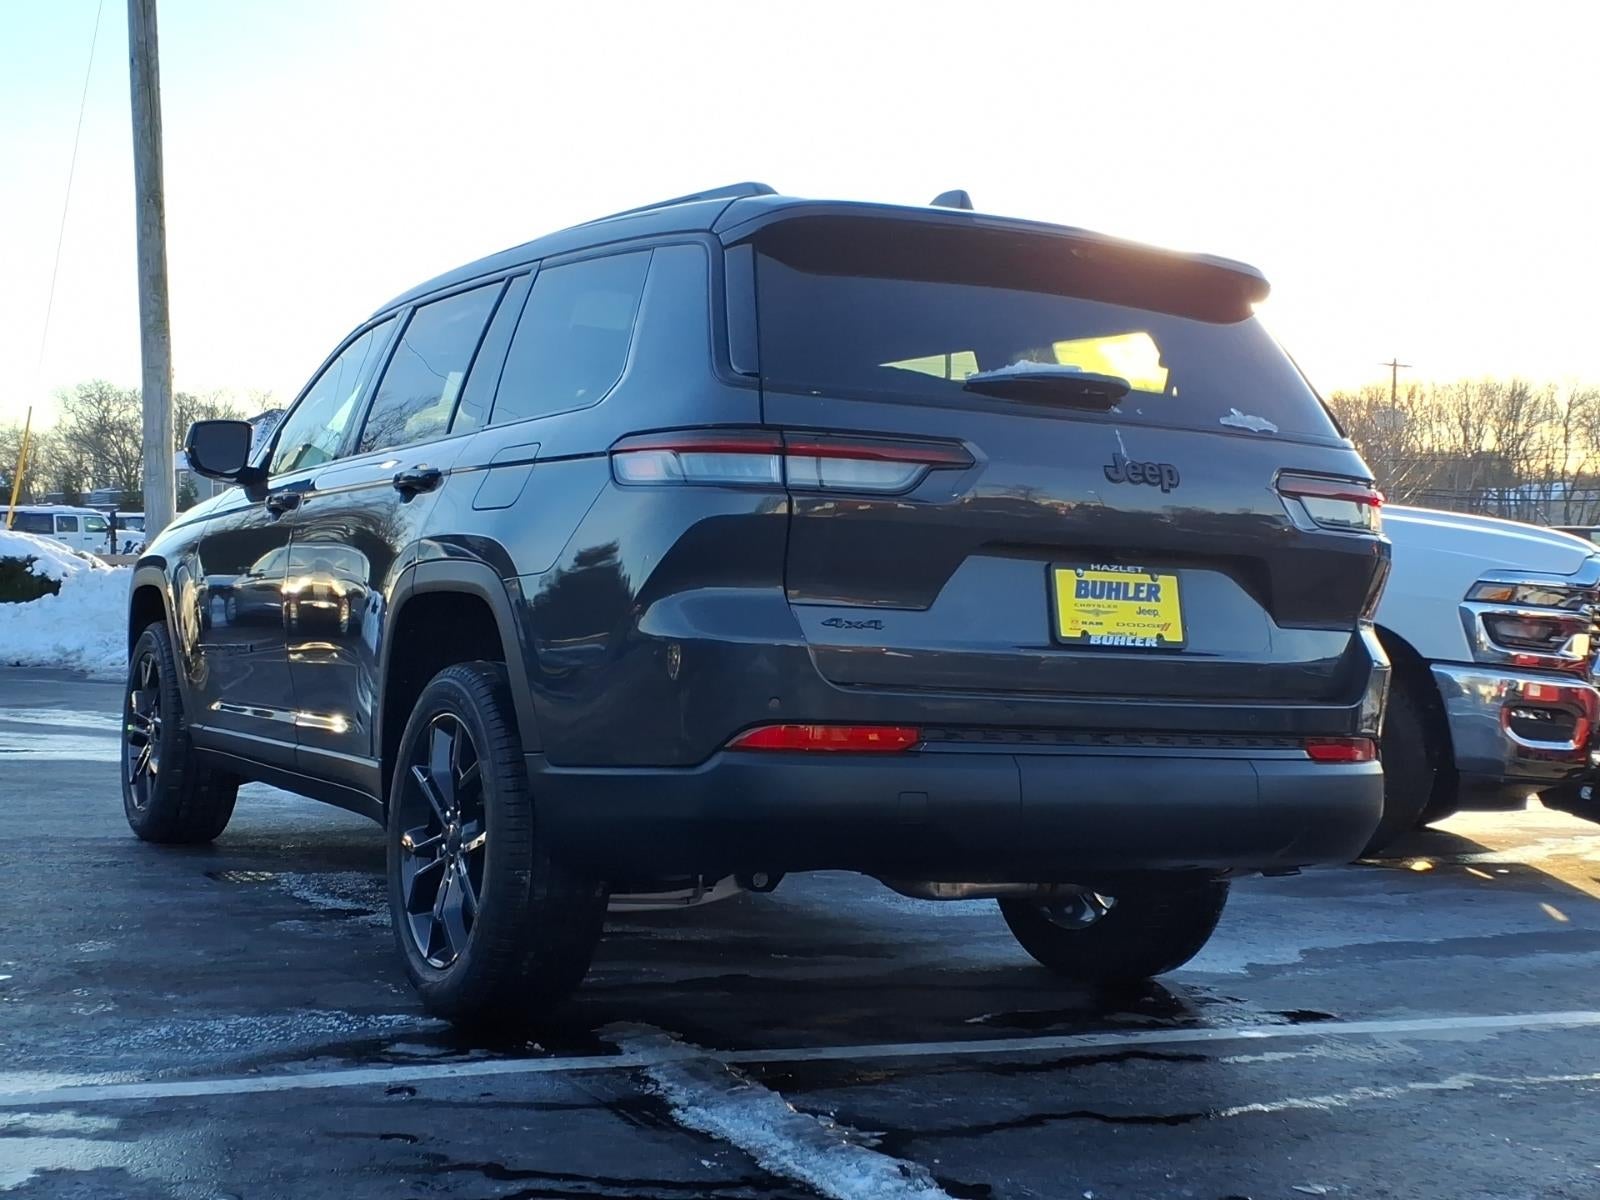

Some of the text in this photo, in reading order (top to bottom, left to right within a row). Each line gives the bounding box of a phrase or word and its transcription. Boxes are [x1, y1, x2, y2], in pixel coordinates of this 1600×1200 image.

[1103, 453, 1180, 493] Jeep
[1090, 564, 1144, 573] HAZLET
[1075, 579, 1161, 602] BUHLER
[1136, 606, 1159, 618] Jeep
[1116, 621, 1163, 629] DODGE
[1089, 635, 1158, 647] BUHLER
